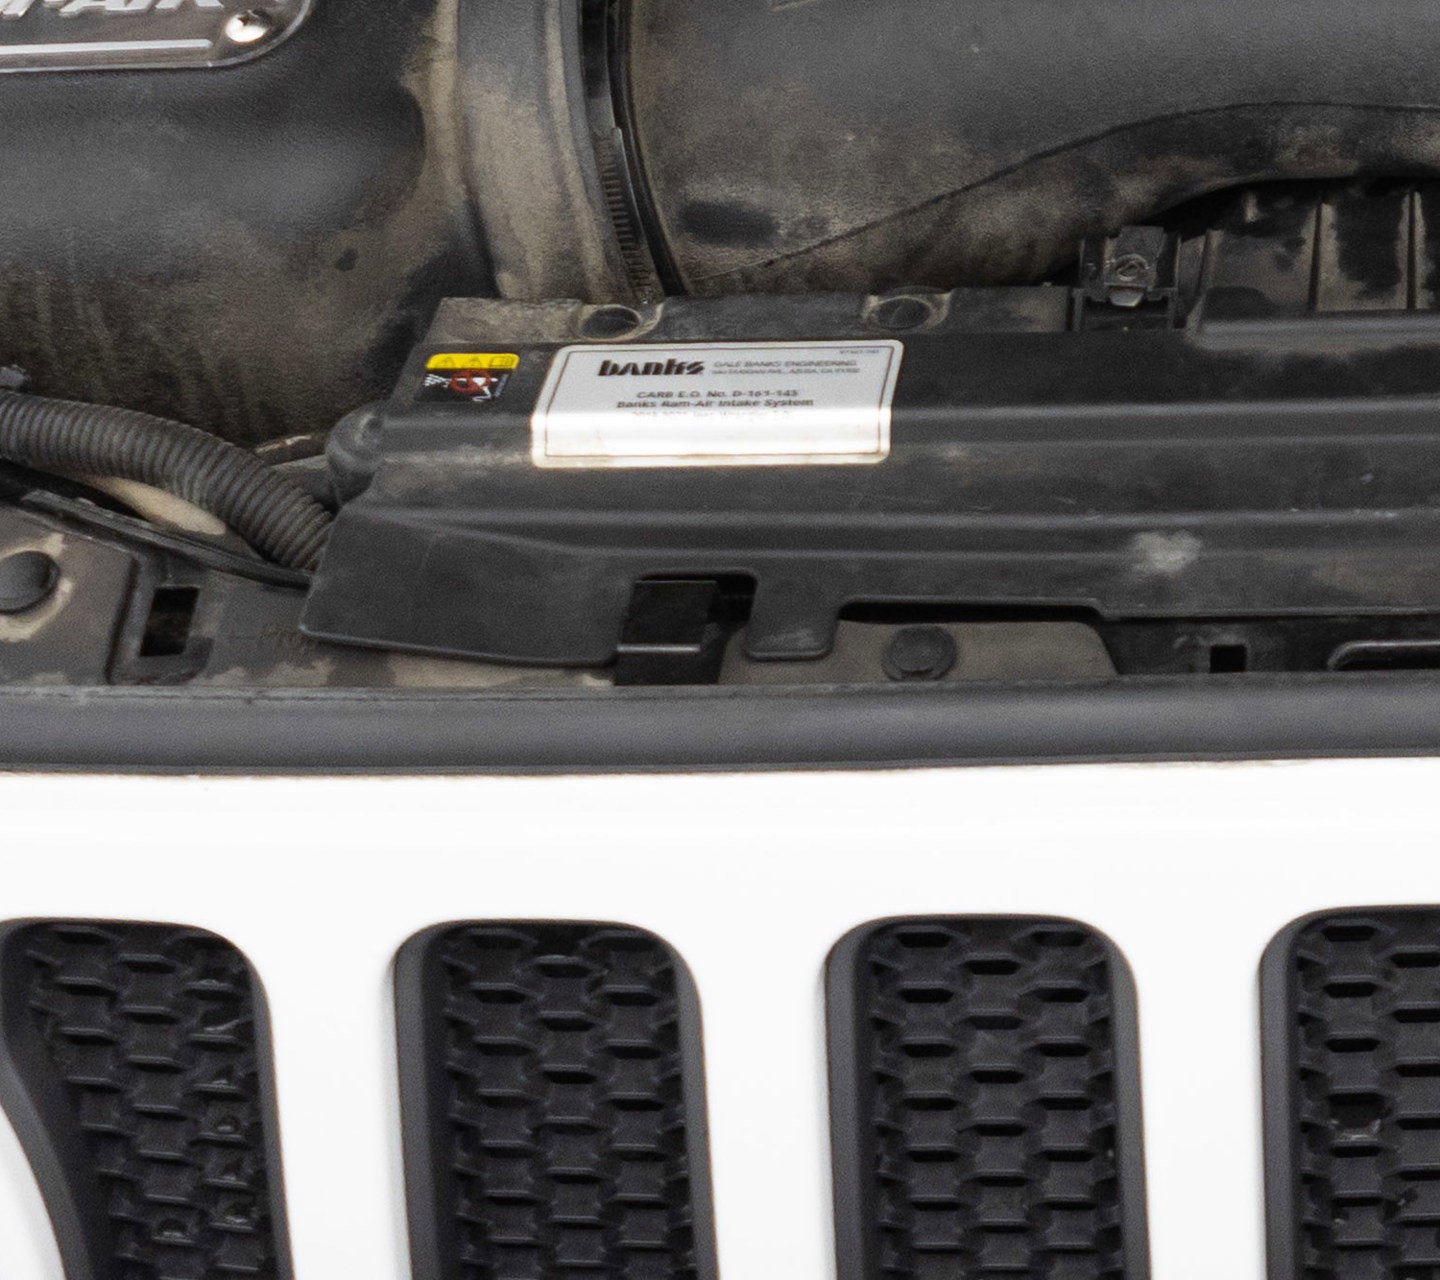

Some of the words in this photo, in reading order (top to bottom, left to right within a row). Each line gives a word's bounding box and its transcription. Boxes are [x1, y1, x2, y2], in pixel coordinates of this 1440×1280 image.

[597, 358, 705, 377] banks
[744, 360, 781, 368] BANKS
[636, 391, 674, 399] CARB
[709, 390, 728, 398] No.
[616, 401, 656, 409] Banks
[661, 400, 712, 408] Ram-Air
[717, 399, 760, 408] Intake
[763, 398, 814, 409] System
